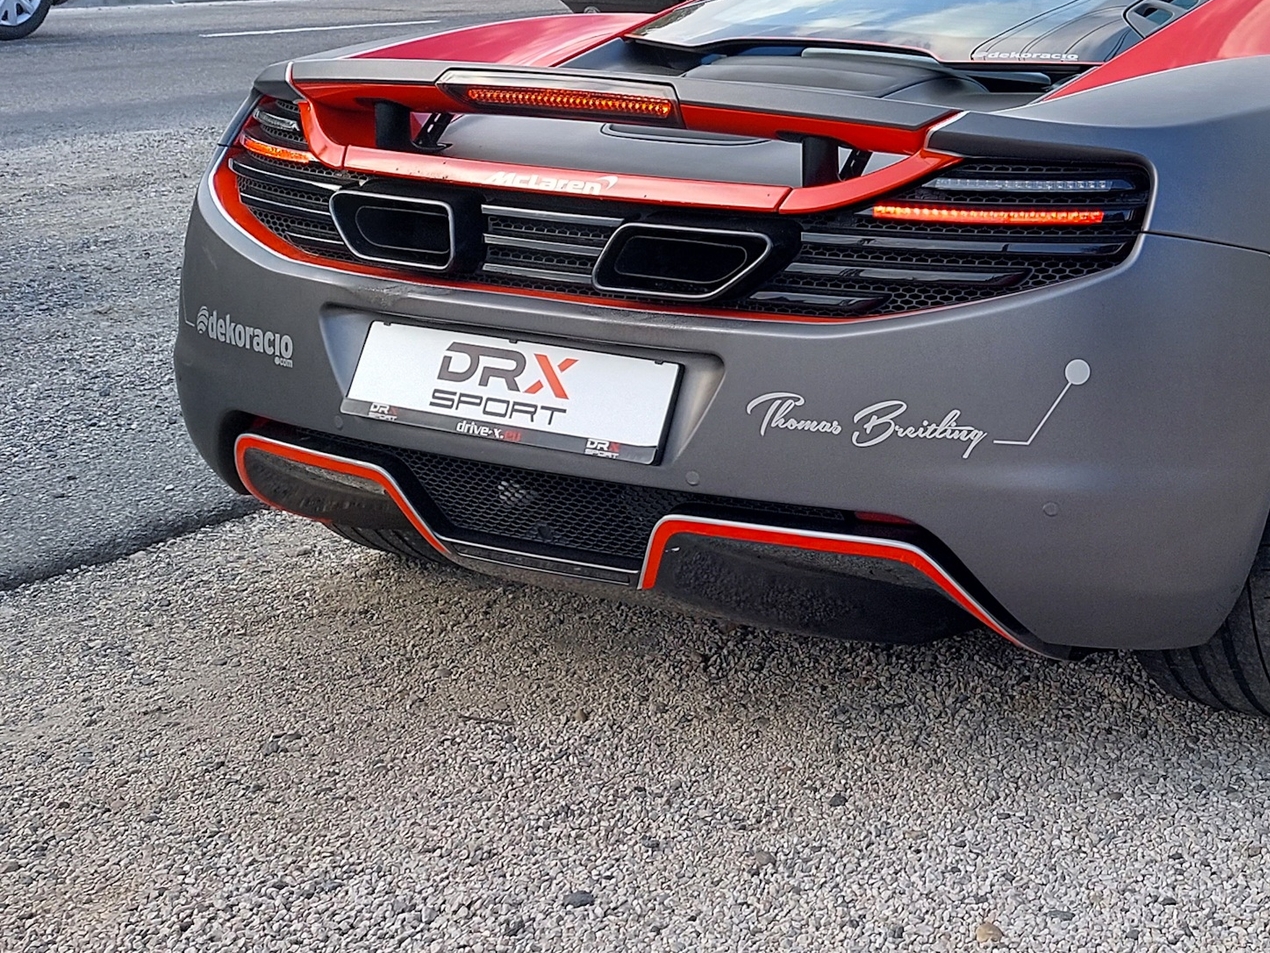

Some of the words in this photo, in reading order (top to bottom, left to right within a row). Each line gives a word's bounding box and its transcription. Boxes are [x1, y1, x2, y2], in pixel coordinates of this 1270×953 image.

[436, 341, 580, 400] DRX
[428, 388, 568, 426] SPORT
[746, 391, 843, 437] Thomas
[851, 400, 988, 460] Breitling
